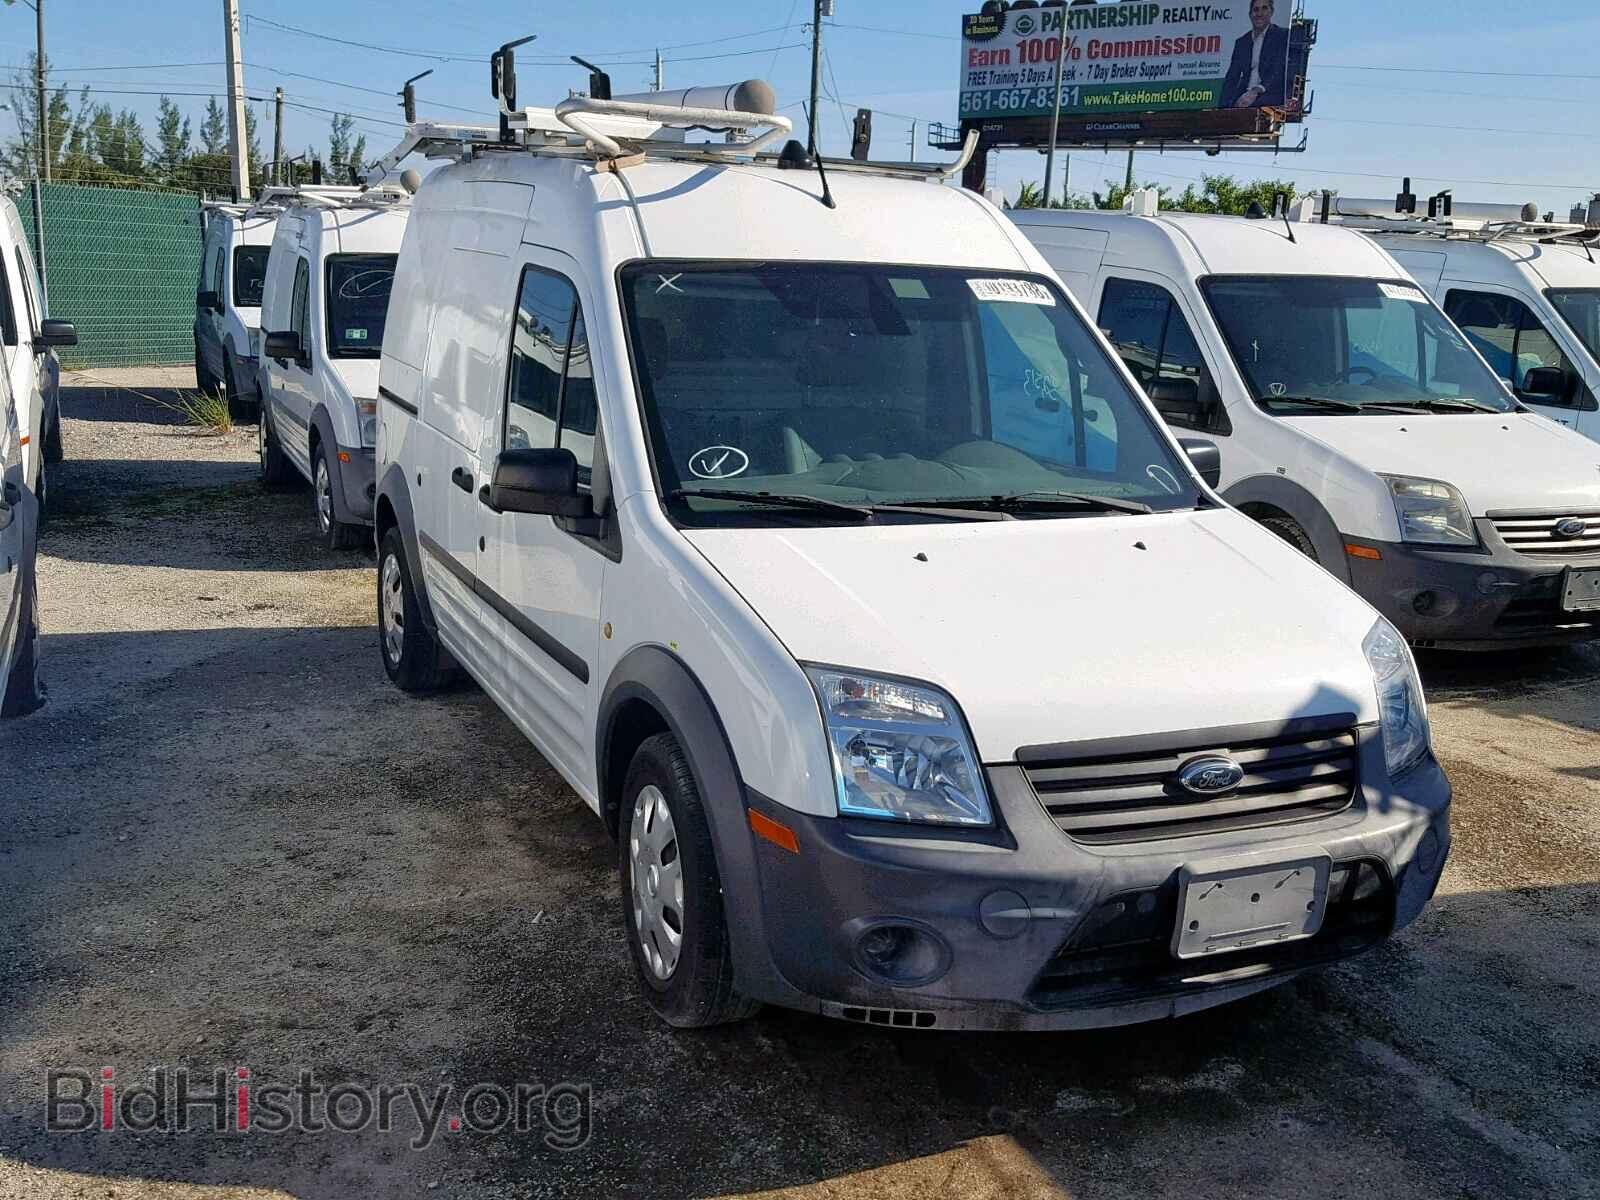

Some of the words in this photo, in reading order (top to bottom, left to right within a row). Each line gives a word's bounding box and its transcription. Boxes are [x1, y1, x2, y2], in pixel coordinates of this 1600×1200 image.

[973, 25, 998, 33] Business
[1041, 4, 1159, 31] PARTNERSHIP
[1163, 6, 1211, 23] REALTY
[1212, 8, 1232, 20] INC.
[968, 48, 1010, 66] Earn
[1016, 36, 1080, 64] 100%
[1087, 34, 1221, 59] Commission
[967, 71, 987, 86] FREE
[989, 68, 1018, 87] Training
[1020, 68, 1025, 83] 5
[1027, 67, 1045, 85] Days
[1046, 68, 1053, 82] A
[1087, 65, 1094, 80] 7
[1095, 63, 1109, 82] Day
[1111, 62, 1138, 79] Broker
[1140, 61, 1172, 80] Support
[961, 86, 1079, 112] 561-667-8361
[1084, 88, 1213, 106] www.TakeHome100.com
[1199, 769, 1233, 788] Ford
